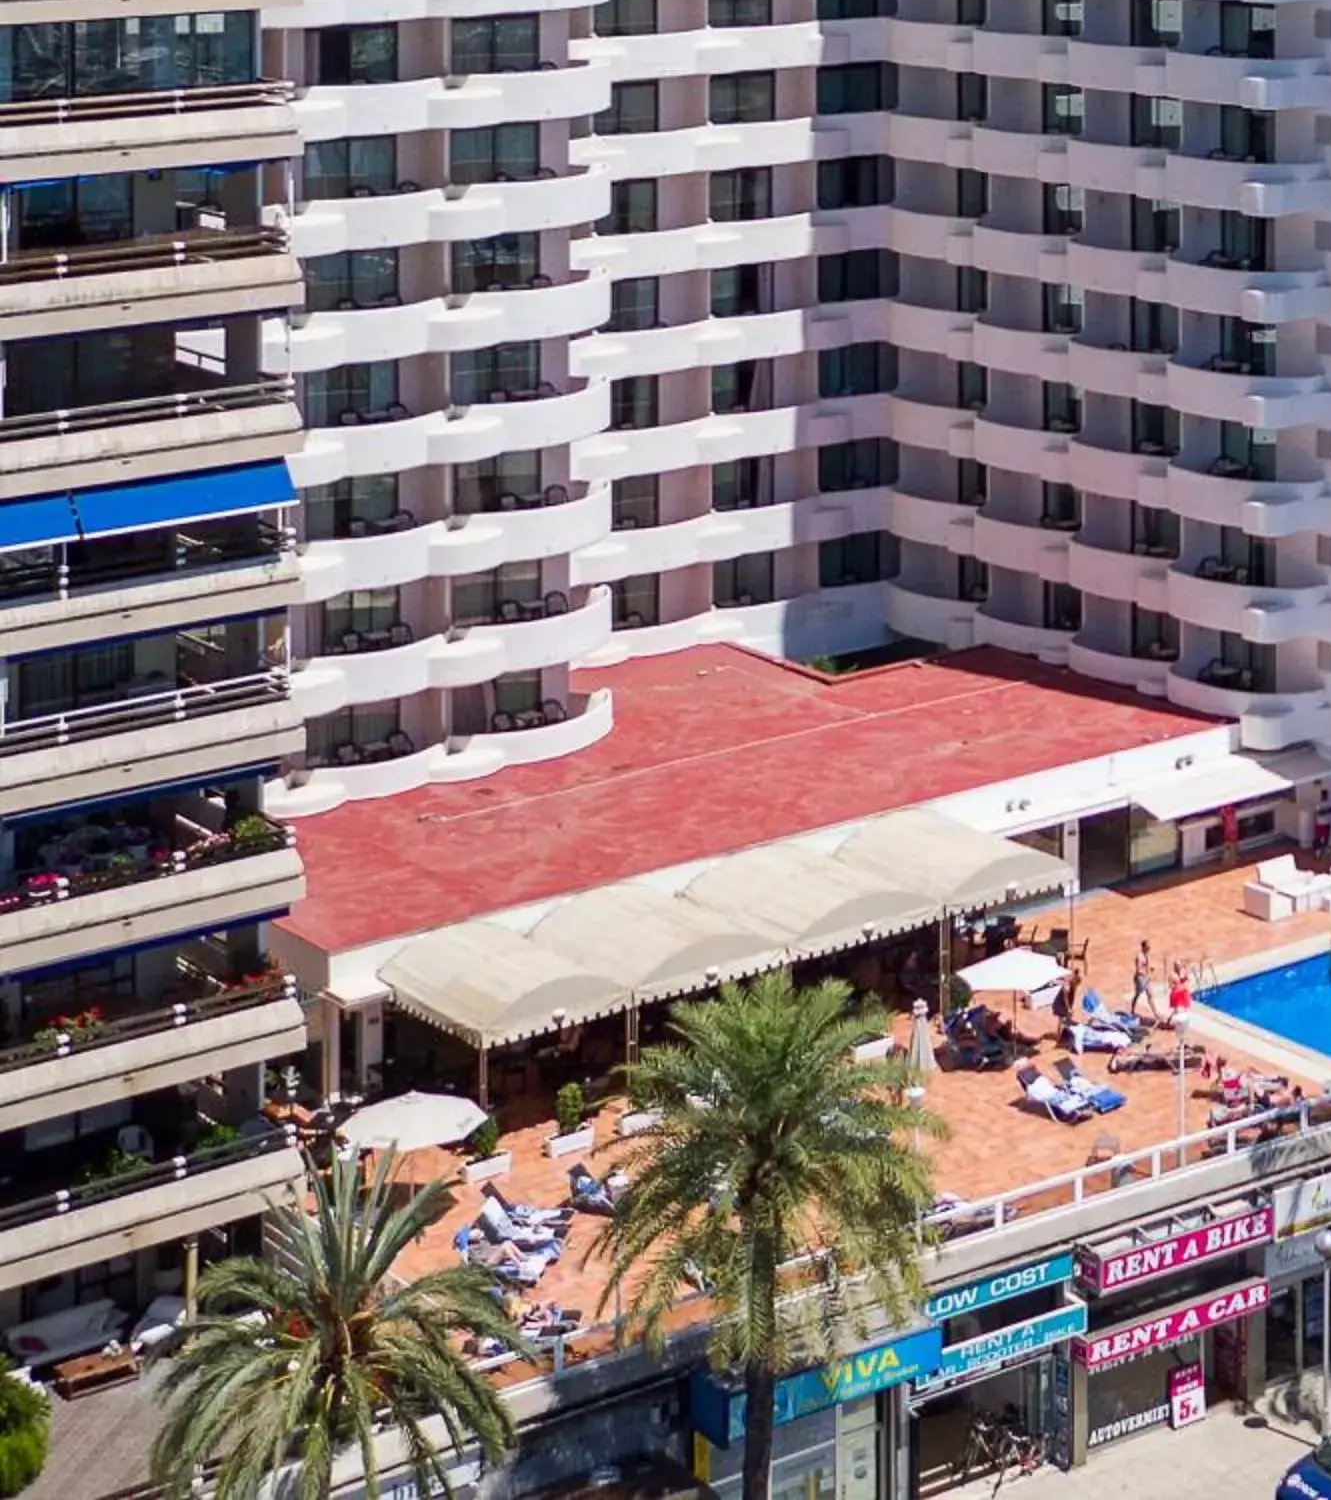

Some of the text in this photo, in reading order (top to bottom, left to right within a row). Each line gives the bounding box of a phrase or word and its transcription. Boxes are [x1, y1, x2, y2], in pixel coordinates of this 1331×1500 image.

[1106, 1242, 1178, 1285] RENT
[1183, 1239, 1199, 1260] A
[1206, 1212, 1267, 1253] BIKE
[925, 1287, 978, 1317] LOW
[990, 1263, 1051, 1297] COST
[960, 1331, 1014, 1359] RENT
[1090, 1285, 1266, 1362] RENT A CAR
[820, 1347, 900, 1390] VIVA
